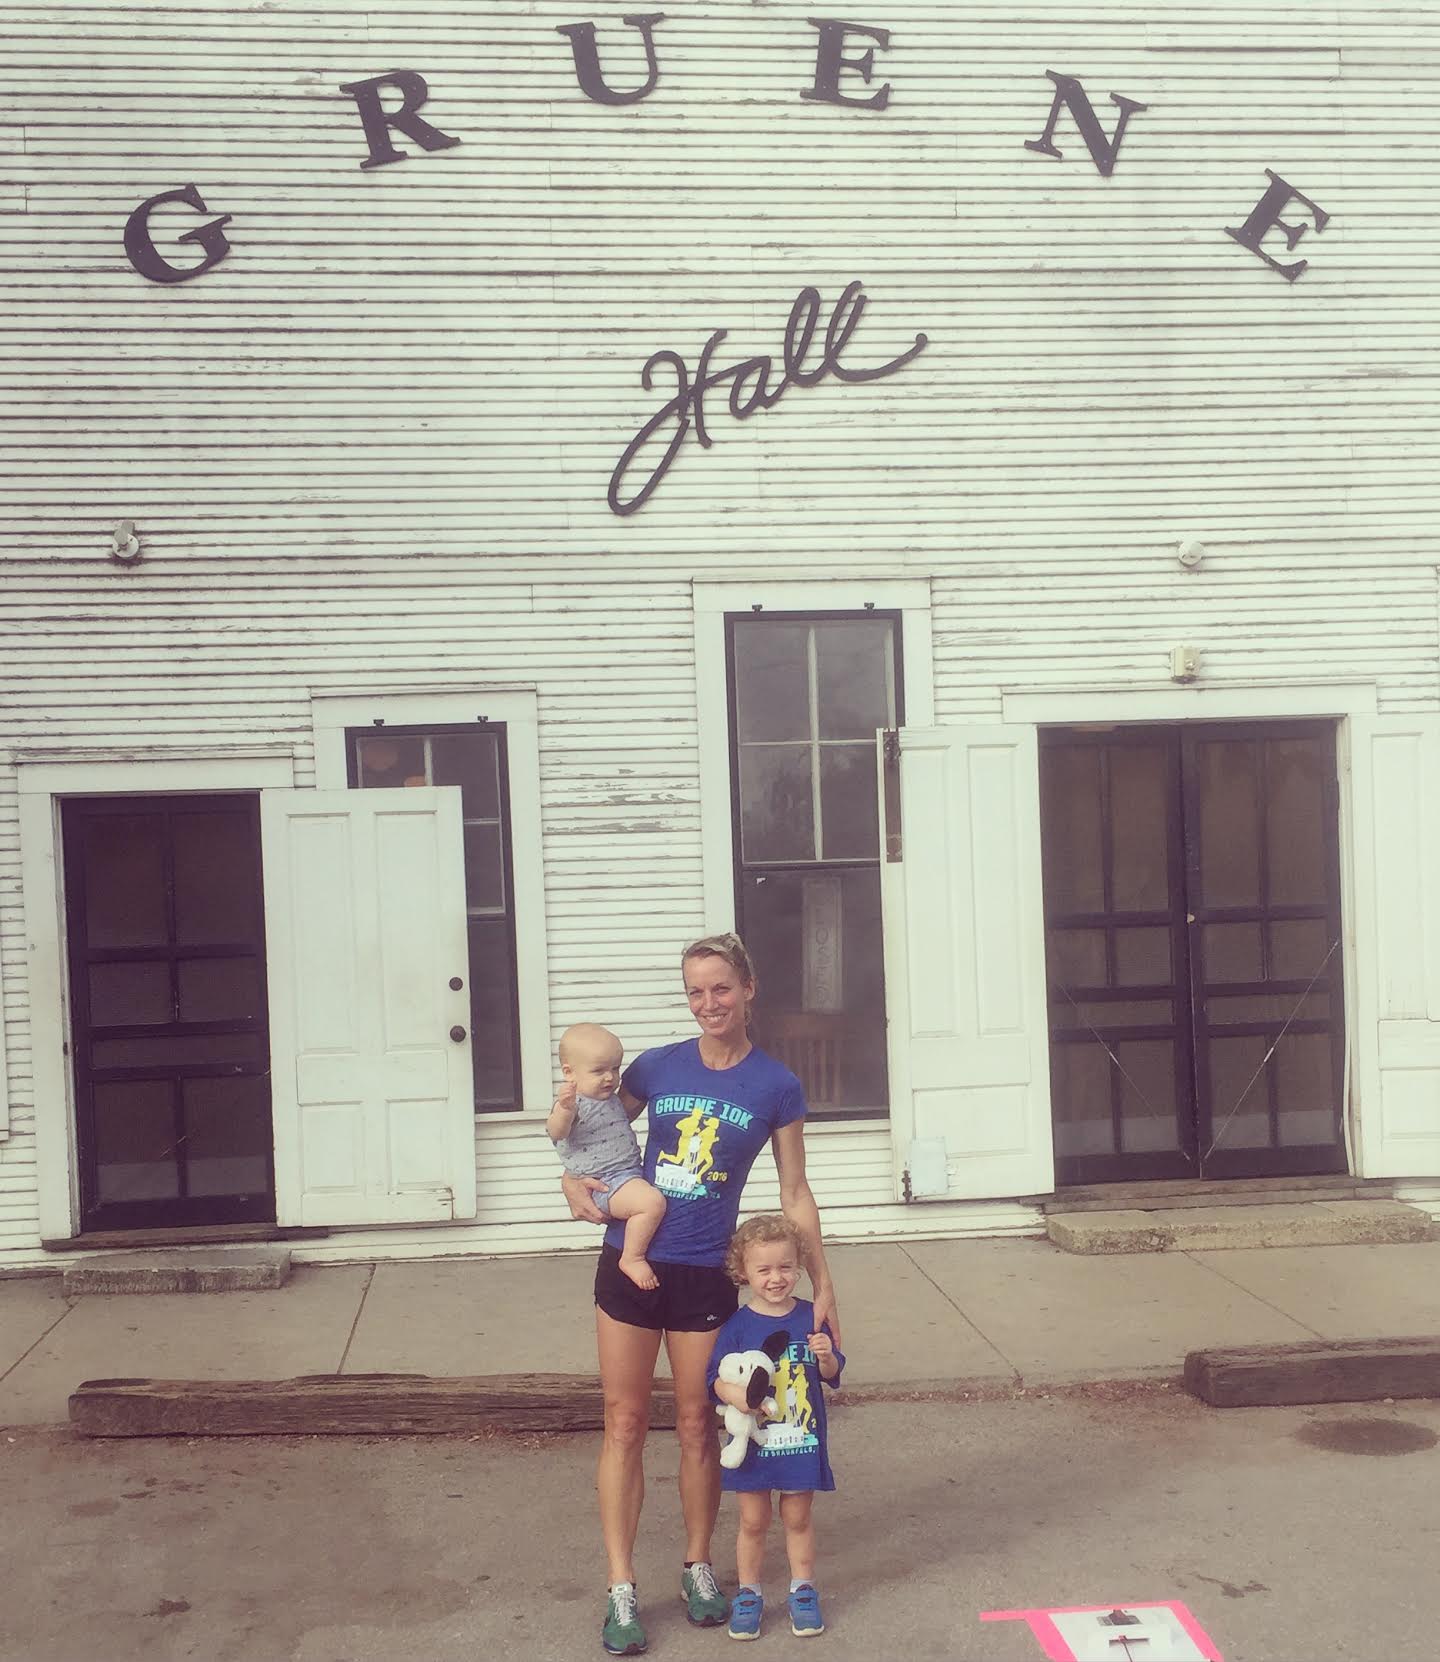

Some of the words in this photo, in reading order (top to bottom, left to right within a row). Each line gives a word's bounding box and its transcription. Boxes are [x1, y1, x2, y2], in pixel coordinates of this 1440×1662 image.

[124, 14, 1329, 283] GRUENE
[608, 280, 928, 516] Hall
[655, 1097, 717, 1115] GRUENE
[719, 1104, 754, 1129] 10K
[706, 1171, 728, 1181] 2016
